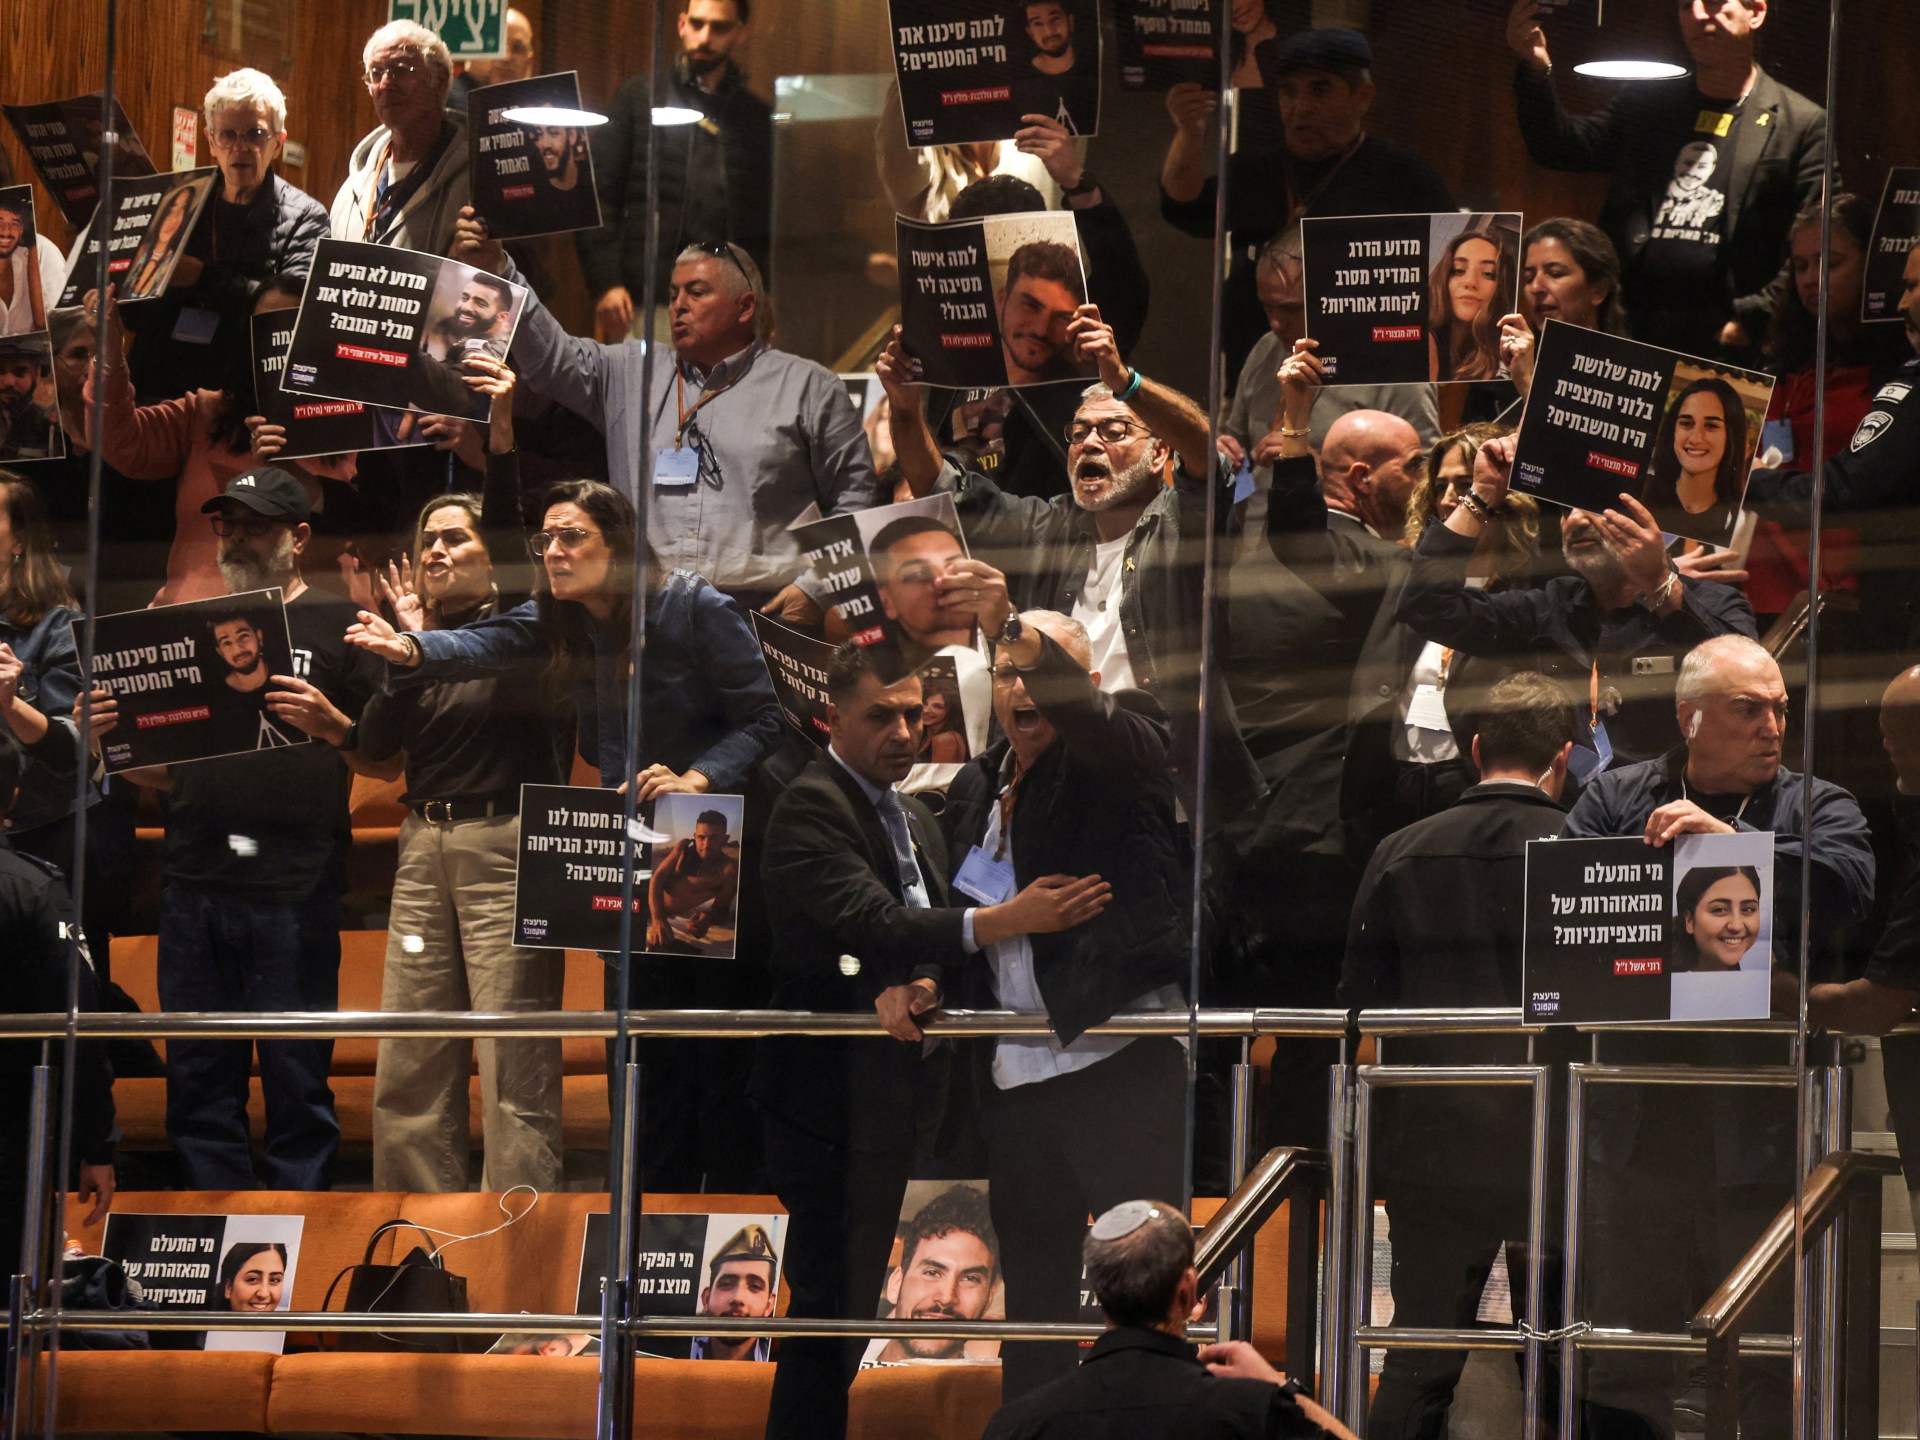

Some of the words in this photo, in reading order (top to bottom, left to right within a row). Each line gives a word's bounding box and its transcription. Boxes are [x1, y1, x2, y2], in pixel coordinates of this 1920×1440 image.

[899, 26, 925, 46] את
[928, 22, 966, 42] סיכנו
[970, 14, 1005, 39] למה
[900, 47, 978, 71] החטופים?
[981, 44, 1007, 63] חיי
[479, 136, 491, 152] את
[492, 128, 525, 151] להסתיר
[495, 156, 530, 176] האמת?
[1893, 189, 1920, 204] בות
[948, 245, 977, 266] למה
[1349, 240, 1381, 258] הדרג
[1384, 239, 1421, 257] מדוע
[912, 250, 946, 268] אישרו
[329, 262, 367, 282] הגיעו
[367, 265, 388, 284] לא
[389, 270, 428, 291] מדוע
[1335, 269, 1370, 286] מסרב
[1373, 267, 1421, 284] המדיני
[917, 274, 937, 295] ליד
[939, 276, 983, 294] מסיבה
[316, 285, 340, 304] את
[342, 287, 378, 310] לחלץ
[1380, 291, 1421, 315] לקחת
[378, 295, 421, 315] כוחות
[940, 302, 988, 320] הגבול?
[1320, 296, 1377, 314] אחריות?
[330, 312, 378, 336] הנובה?
[380, 319, 415, 340] מבלי
[271, 330, 295, 347] מה
[1320, 356, 1337, 365] מועצ
[1572, 354, 1627, 384] שלושת
[1628, 369, 1663, 392] למה
[1555, 379, 1614, 410] התצפית
[1617, 395, 1655, 421] בלוני
[1546, 405, 1620, 442] מושבתים?
[1622, 428, 1647, 449] היו
[1520, 462, 1545, 475] מועצת
[824, 538, 855, 565] איך
[117, 646, 157, 670] סיכנו
[160, 636, 196, 661] למה
[762, 641, 799, 672] נפרצה
[91, 650, 115, 673] את
[92, 669, 174, 697] החטופים?
[176, 665, 202, 684] חיי
[779, 667, 816, 700] קלות?
[547, 807, 569, 826] לנו
[572, 812, 609, 829] חסמו
[612, 812, 645, 832] לה
[528, 835, 581, 854] הבריחה
[584, 839, 616, 856] נתיב
[1584, 861, 1641, 884] התעלם
[1645, 863, 1663, 881] מי
[1551, 894, 1576, 915] של
[1580, 894, 1663, 914] מהאזהרות
[523, 917, 548, 927] מועצת
[1554, 924, 1662, 945] התצפיתניות?
[1629, 961, 1646, 972] אשל
[1647, 961, 1661, 971] רוני
[1533, 991, 1560, 1001] מועצת
[1533, 1003, 1558, 1012] אוקטובר
[150, 1234, 197, 1254] התעלם
[200, 1237, 215, 1253] מי
[122, 1260, 142, 1278] של
[679, 1252, 694, 1268] מי
[143, 1262, 210, 1278] מהאזהרות
[639, 1279, 655, 1294] נח
[657, 1279, 691, 1295] מוצב
[143, 1289, 206, 1305] התצפיתני
